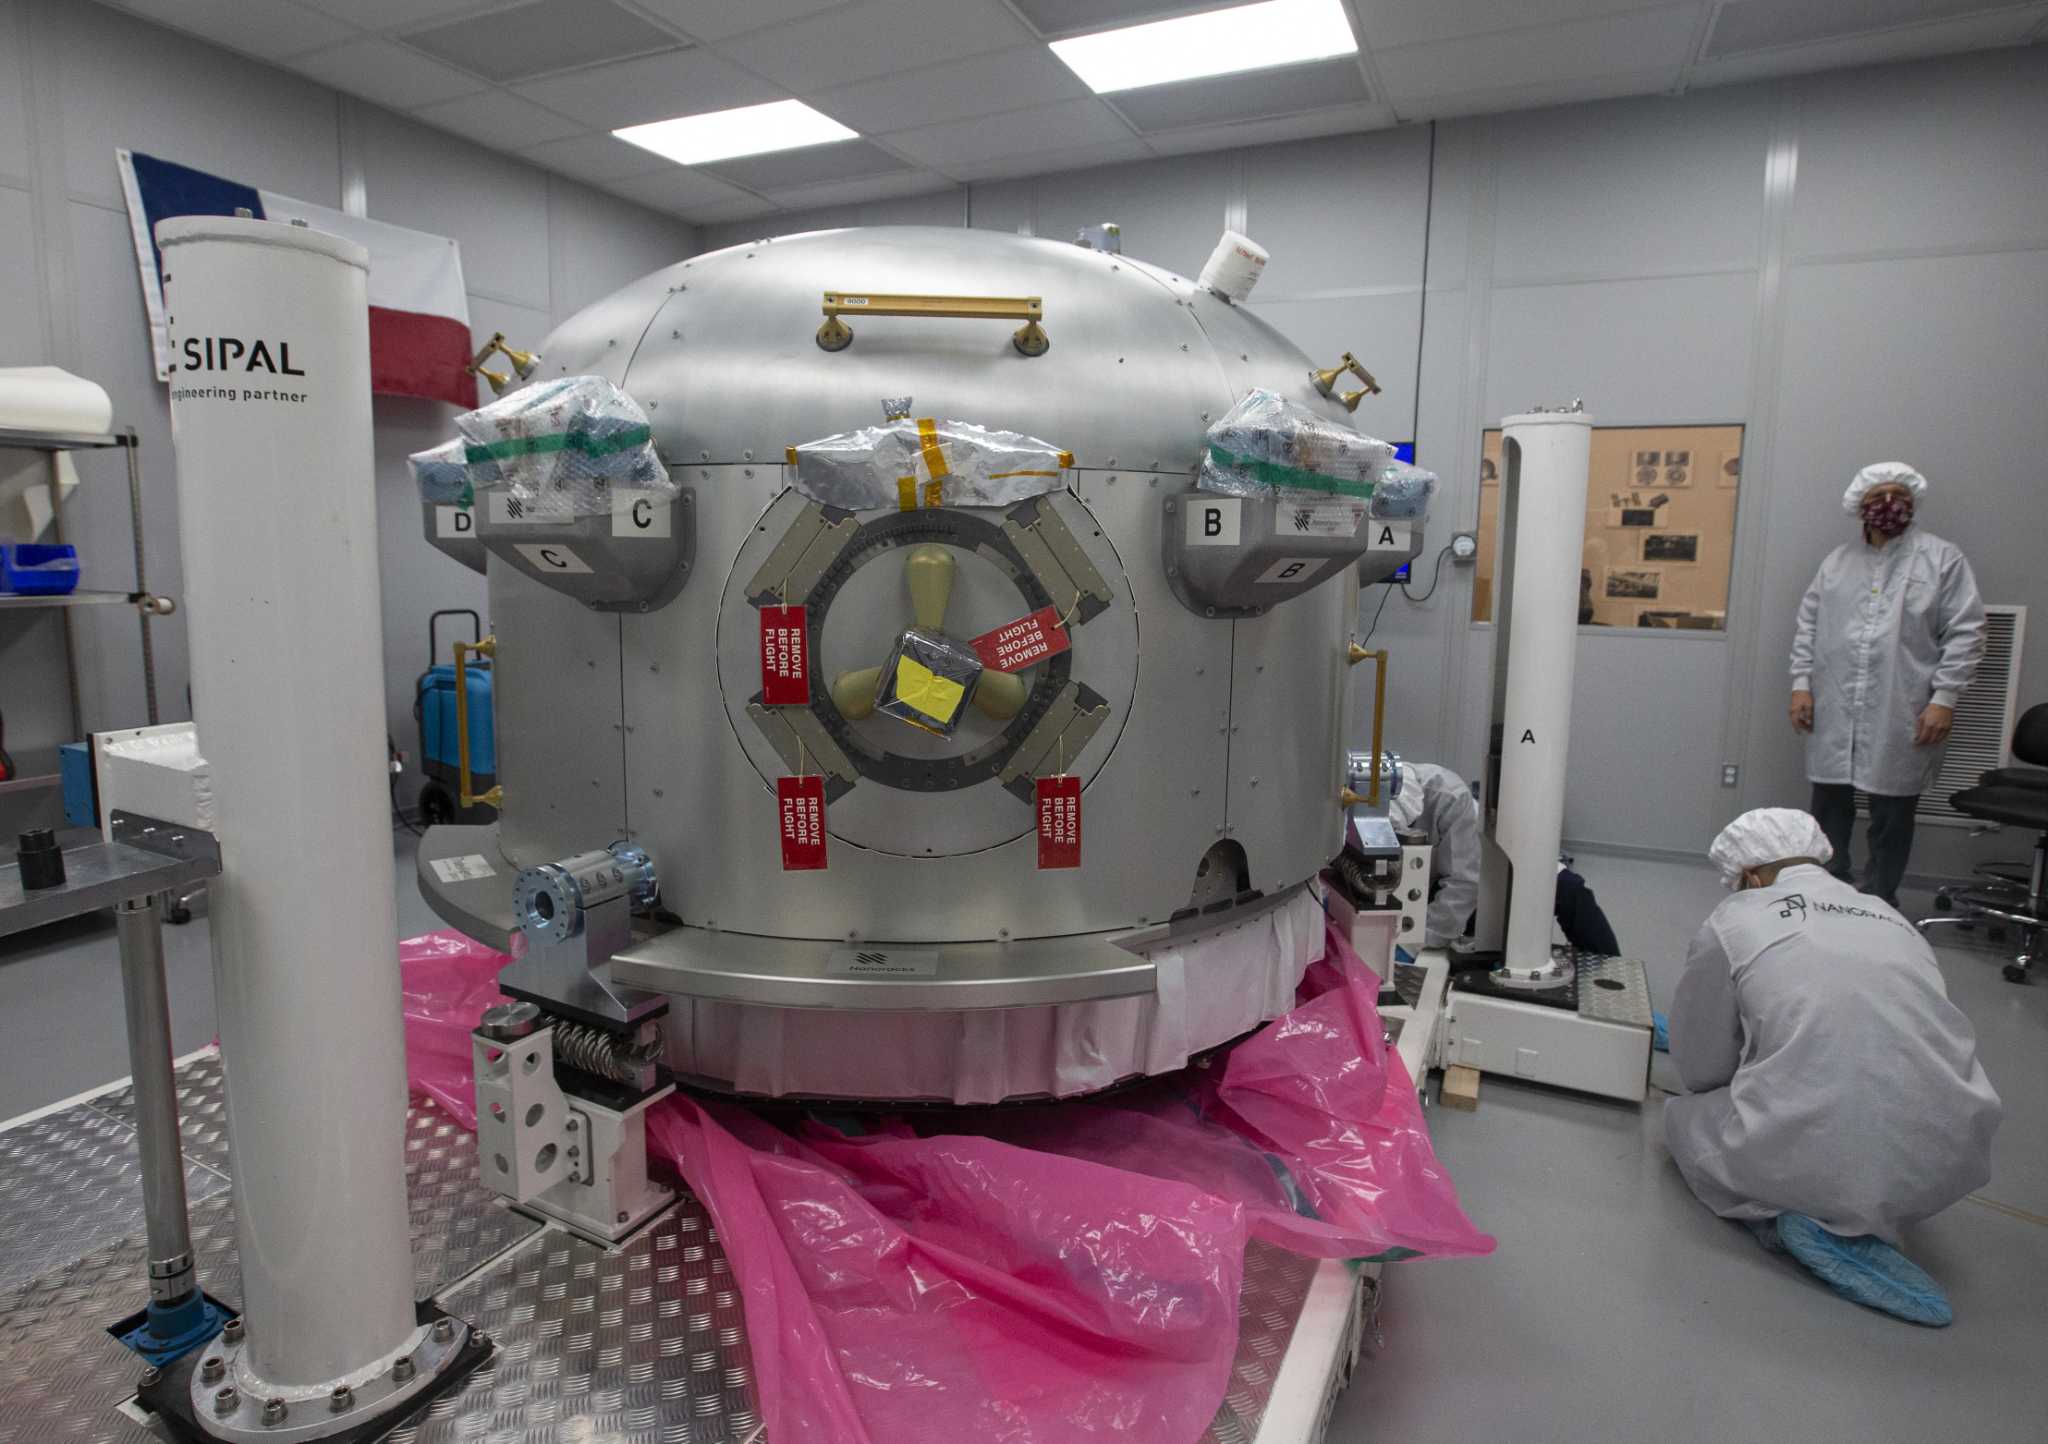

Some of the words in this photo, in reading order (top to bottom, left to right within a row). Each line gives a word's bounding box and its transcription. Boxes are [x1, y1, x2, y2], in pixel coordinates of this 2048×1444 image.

[184, 337, 305, 376] SIPAL
[243, 388, 307, 402] partner
[455, 512, 471, 532] D
[632, 499, 652, 529] C
[1204, 508, 1222, 537] B
[1378, 527, 1395, 545] A
[540, 549, 567, 568] C
[1278, 563, 1304, 578] B
[996, 630, 1044, 656] BEFORE
[999, 618, 1039, 643] FLIGHT
[765, 628, 776, 672] FLIGHT
[778, 628, 789, 678] BEFORE
[791, 628, 802, 679] REMOVE
[1000, 642, 1048, 669] REMOVE
[1520, 729, 1536, 744] A
[783, 798, 795, 839] FLIGHT
[796, 797, 807, 845] BEFORE
[808, 796, 820, 846] REMOVE
[1042, 797, 1052, 838] FLIGHT
[1054, 797, 1064, 844] BEFORE
[1066, 796, 1076, 845] REMOVE
